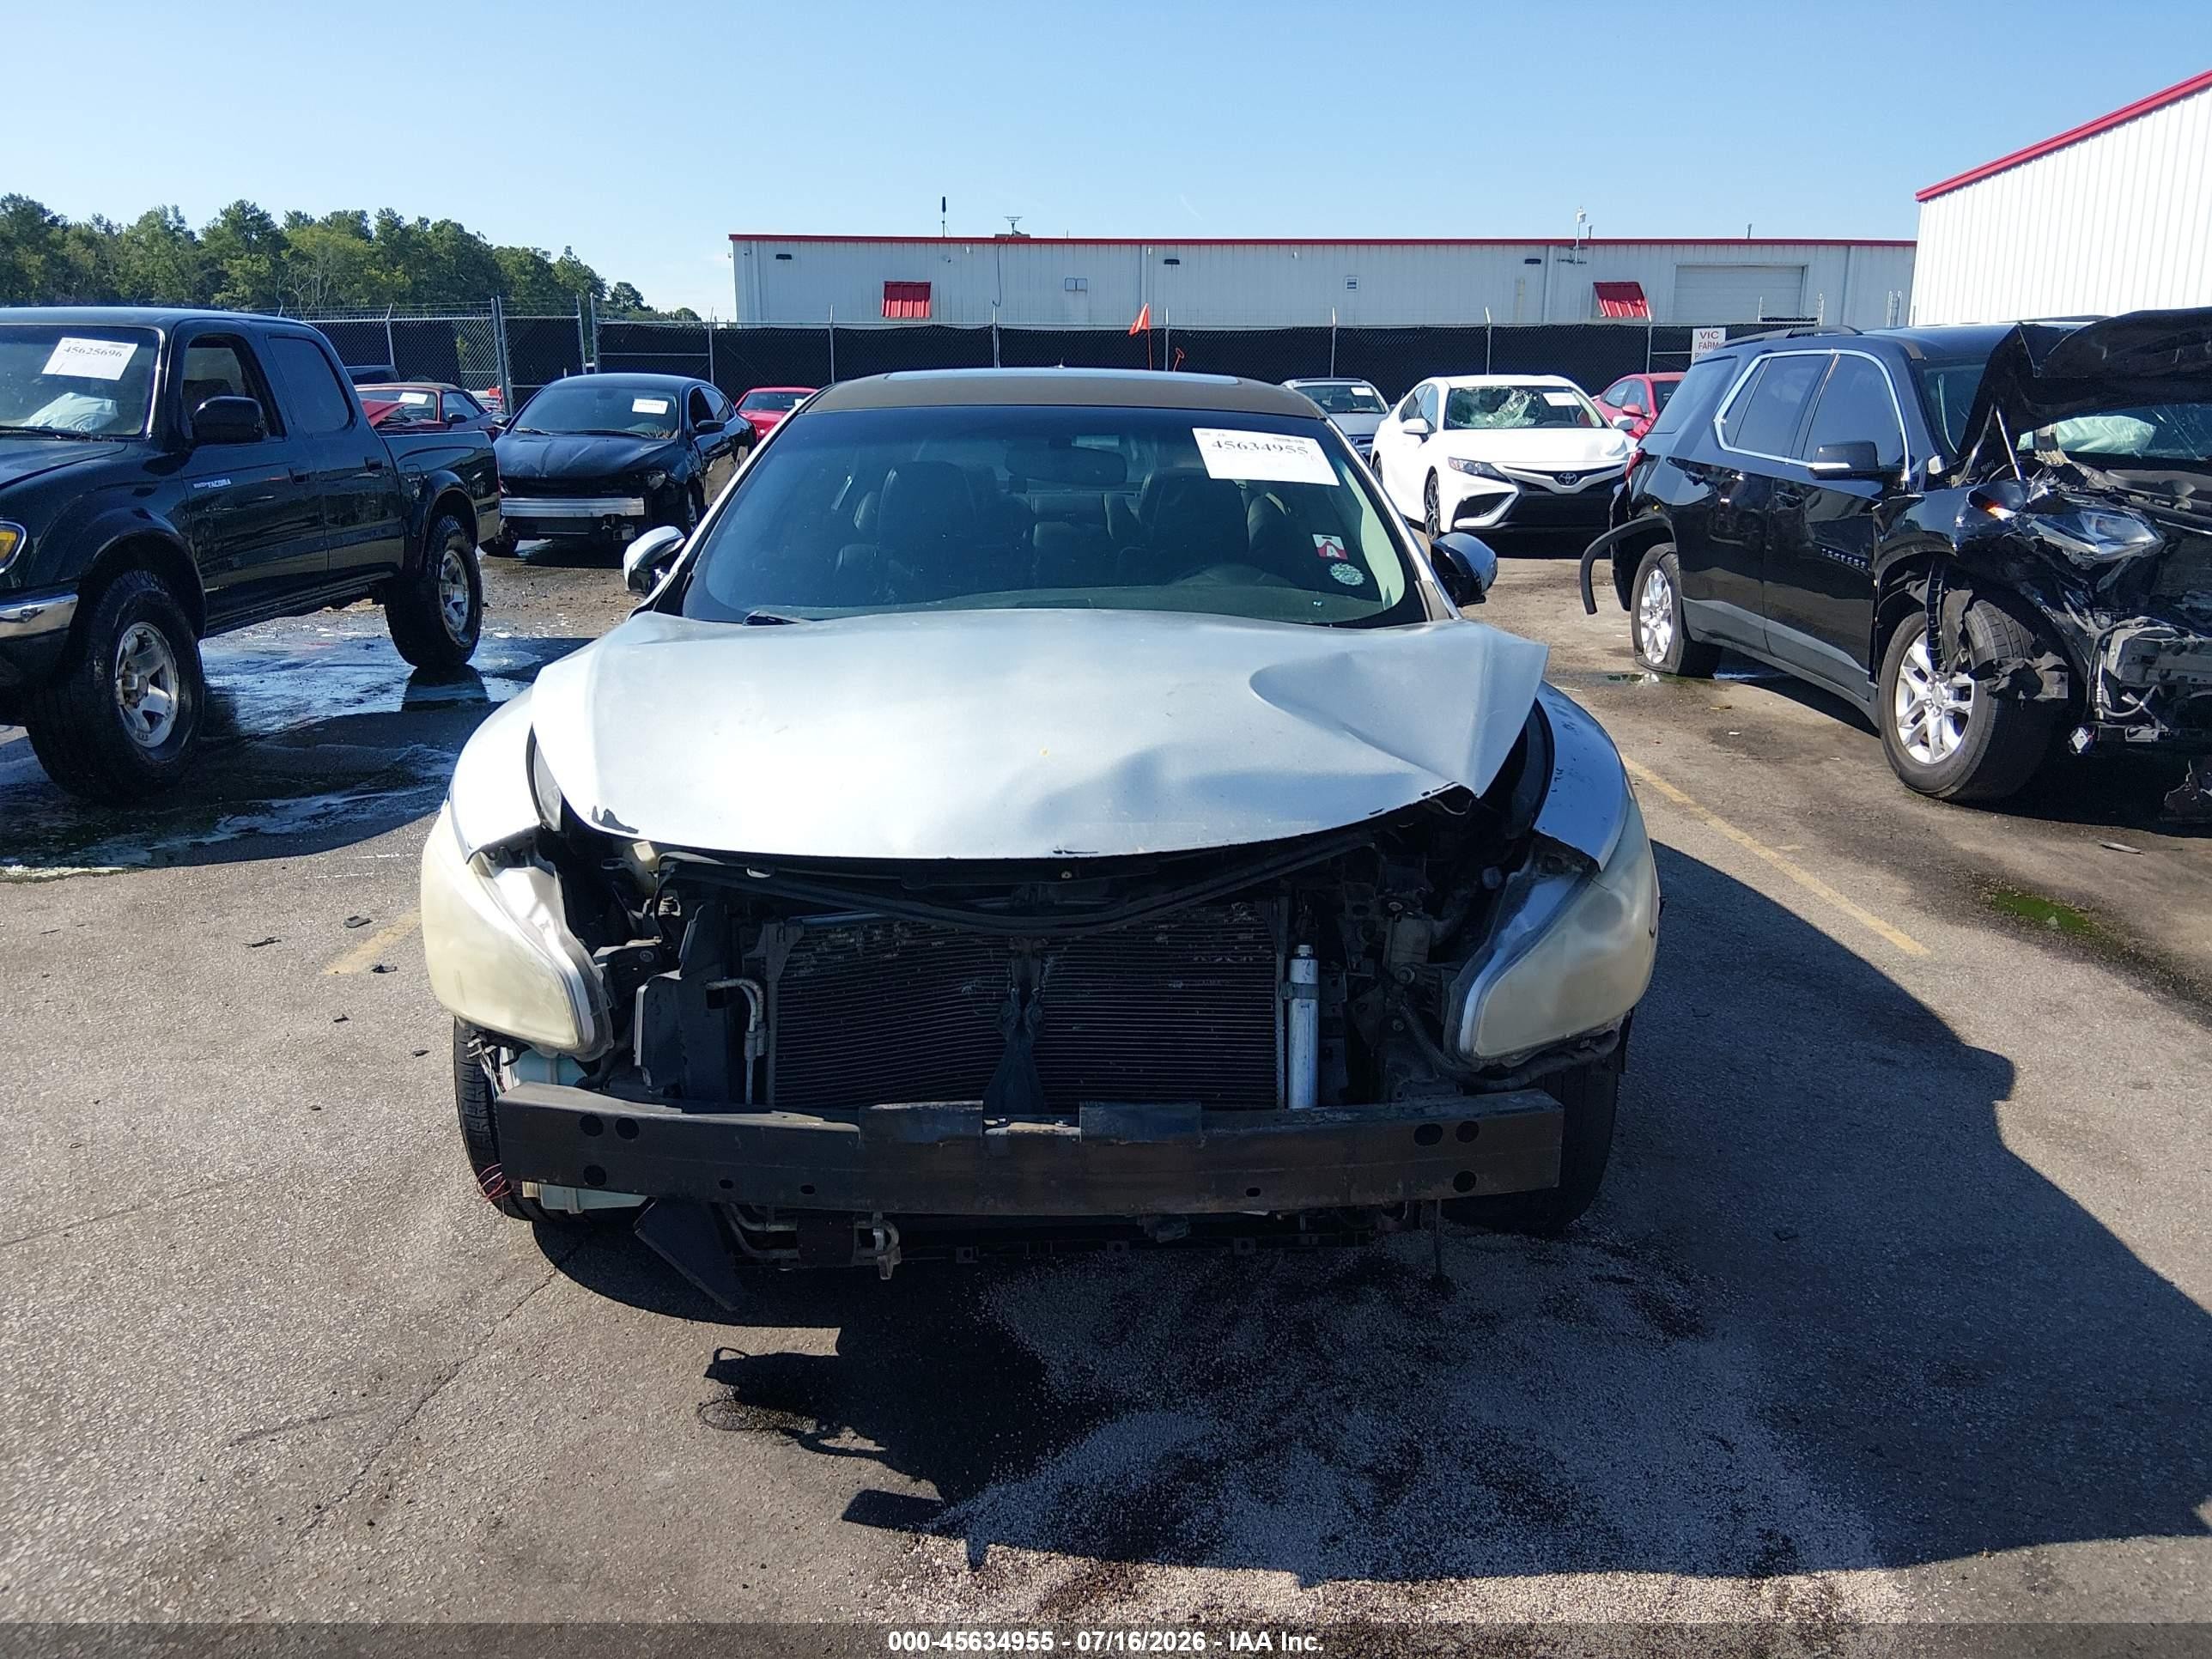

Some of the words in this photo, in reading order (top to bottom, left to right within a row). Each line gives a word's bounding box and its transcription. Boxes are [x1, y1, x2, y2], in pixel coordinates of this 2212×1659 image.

[1699, 331, 1719, 339] VIC
[64, 346, 123, 357] 45625696
[1211, 440, 1310, 456] 45634955
